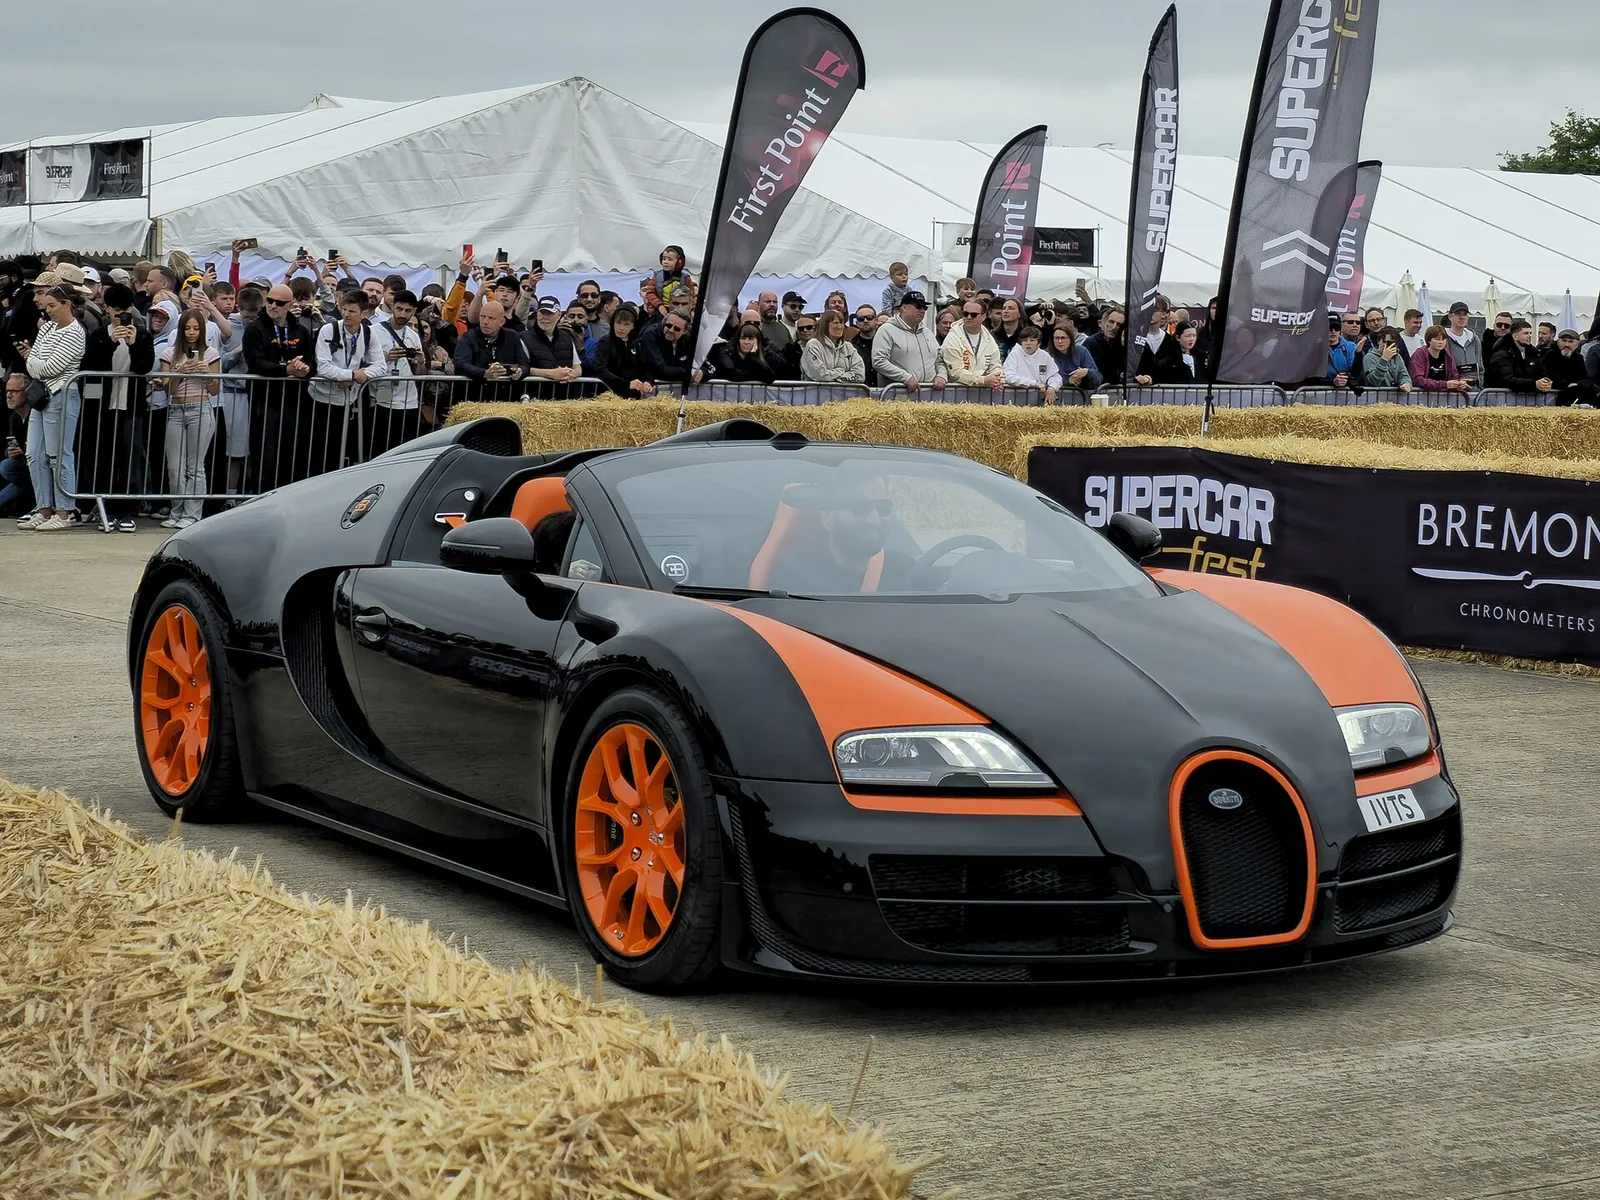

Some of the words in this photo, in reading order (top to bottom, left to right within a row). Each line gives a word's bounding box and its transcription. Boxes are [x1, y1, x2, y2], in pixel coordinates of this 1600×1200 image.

[727, 164, 784, 234] First
[764, 87, 830, 165] Point
[1146, 87, 1178, 253] SUPERCAR
[990, 198, 1028, 278] Point
[1039, 240, 1054, 250] First
[1055, 241, 1071, 250] Point
[1250, 307, 1316, 326] SUPERCA
[1084, 474, 1275, 545] SUPERCAR
[1163, 536, 1266, 580] fest
[1459, 602, 1596, 632] CHRONOMETERS
